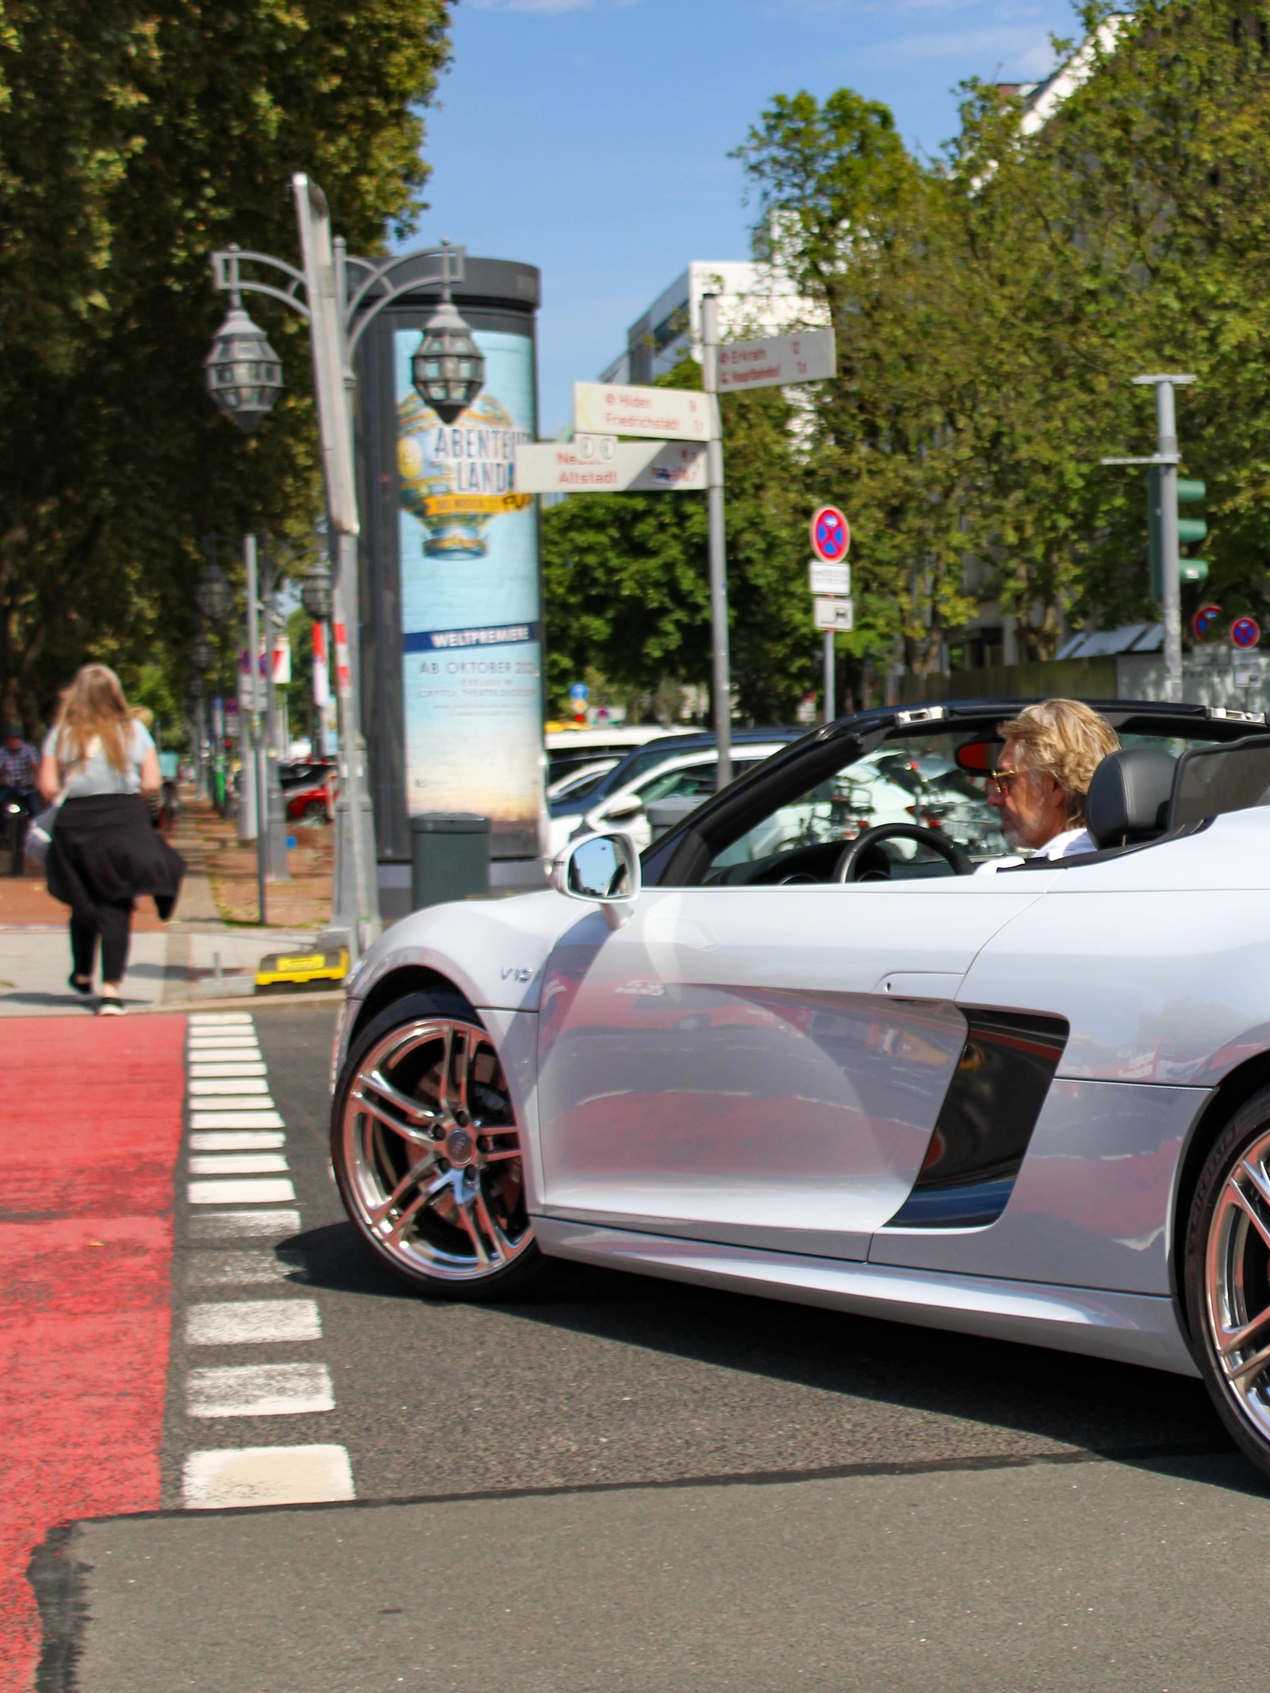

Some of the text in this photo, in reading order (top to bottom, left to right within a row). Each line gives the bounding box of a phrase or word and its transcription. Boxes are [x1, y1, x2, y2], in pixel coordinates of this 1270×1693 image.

[619, 394, 652, 409] Hilden
[606, 412, 680, 431] Friedrichstadt
[457, 461, 508, 494] LAND
[559, 471, 618, 485] Altstadt
[431, 626, 529, 647] WELTPREMIERE
[420, 662, 441, 674] AB
[447, 661, 511, 675] OKTOBER
